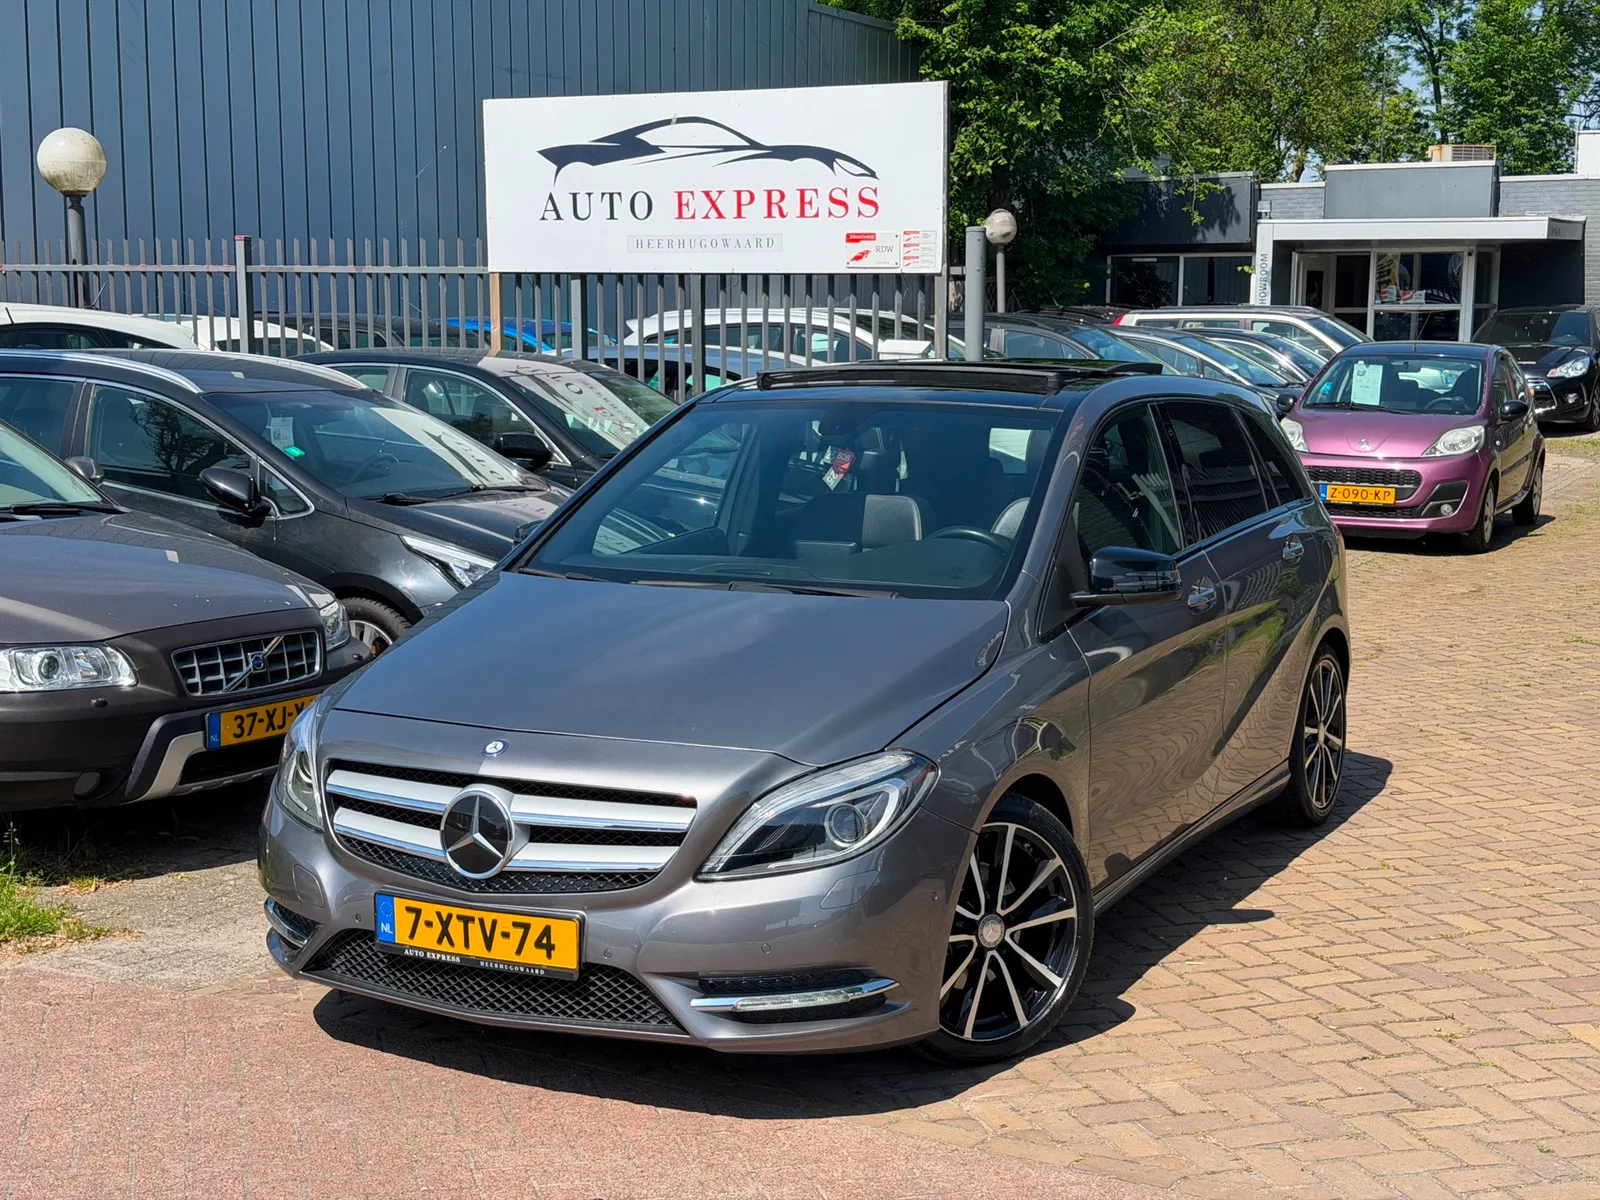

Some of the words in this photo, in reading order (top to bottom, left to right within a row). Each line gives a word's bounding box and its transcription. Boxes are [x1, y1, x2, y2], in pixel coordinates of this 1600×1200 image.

[539, 190, 653, 221] AUTO
[674, 186, 880, 220] EXPRESS
[635, 237, 775, 249] HEERHUGOWAARD
[875, 245, 894, 253] RDW
[1258, 253, 1269, 305] HOWROOM
[1330, 487, 1391, 501] Z-090-KP
[210, 734, 219, 742] NL
[380, 921, 394, 934] NL
[404, 905, 556, 960] 7-XTV-74
[404, 948, 425, 958] AUTO
[426, 951, 461, 963] EXPRESS
[479, 960, 545, 975] HEERHUGOWAARD
